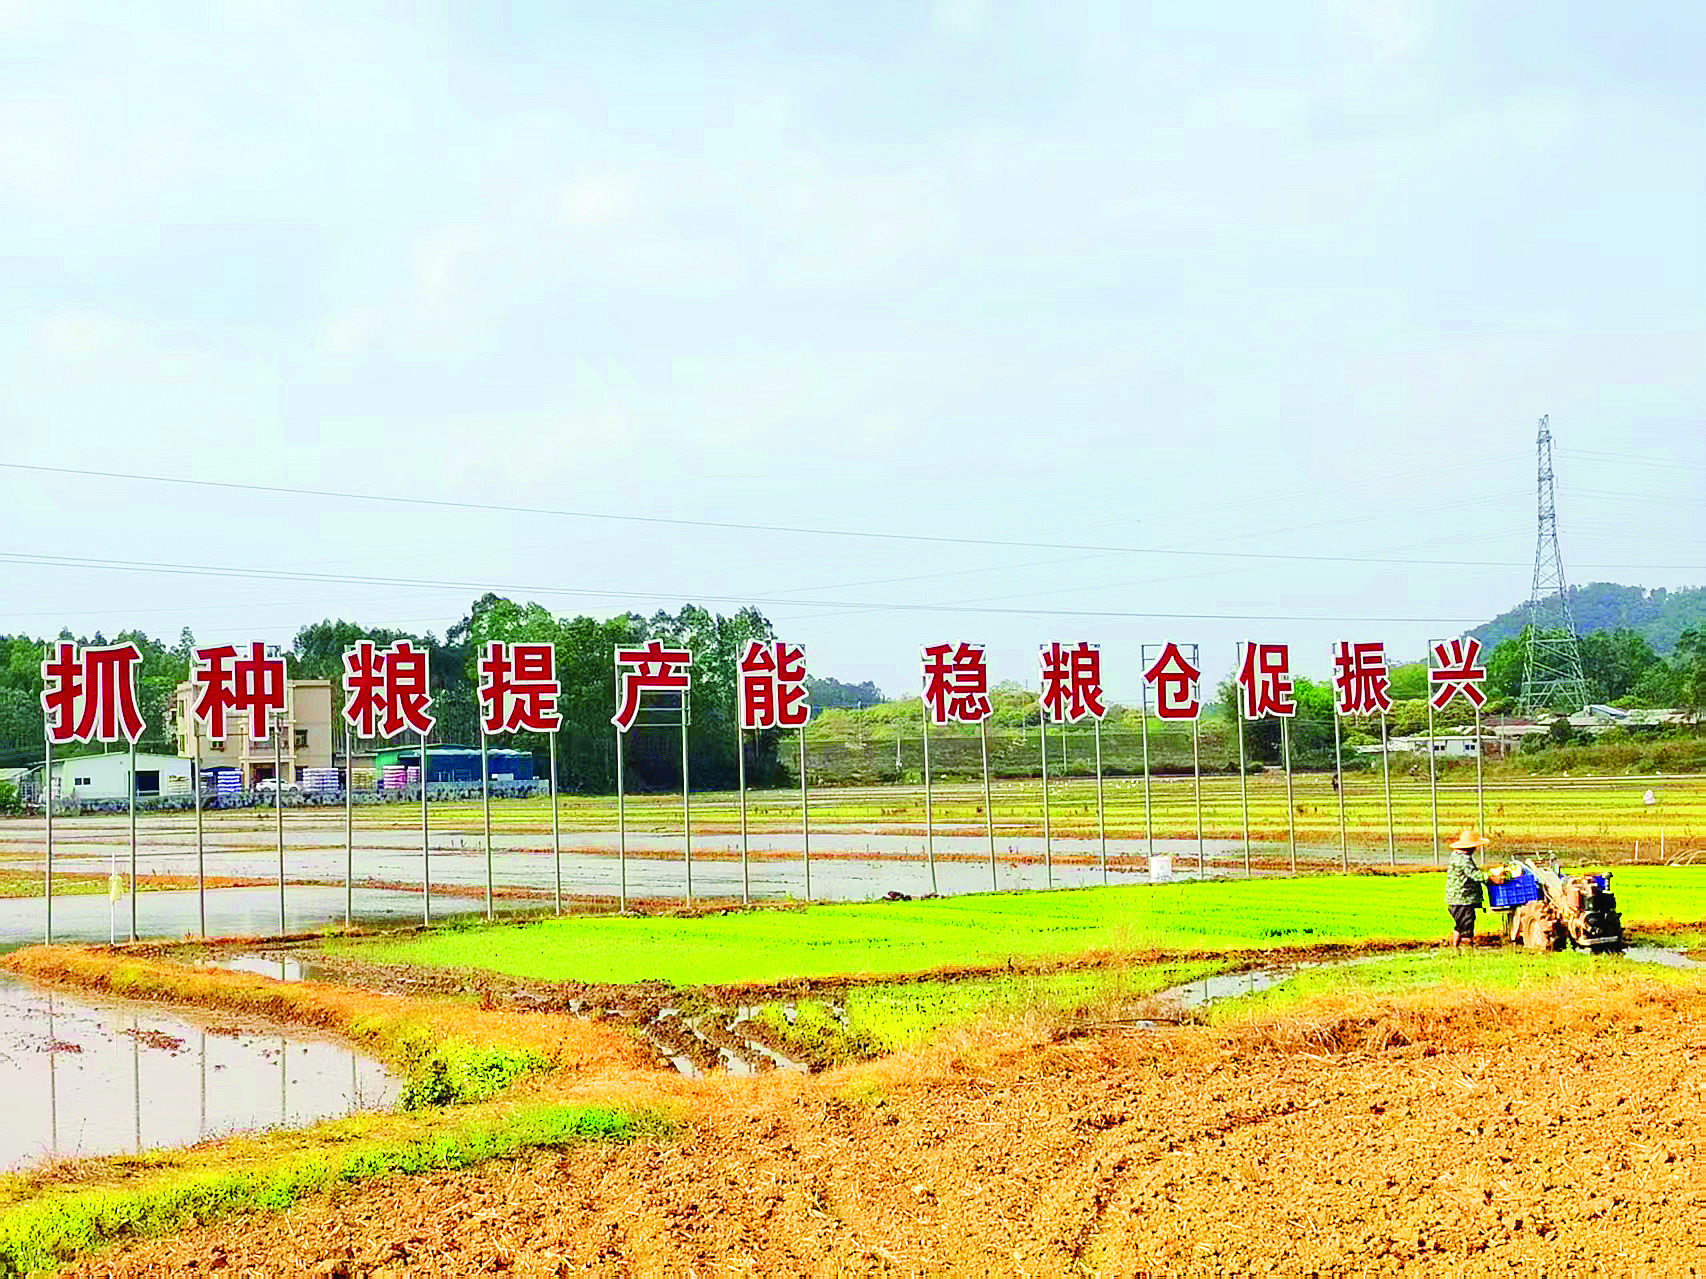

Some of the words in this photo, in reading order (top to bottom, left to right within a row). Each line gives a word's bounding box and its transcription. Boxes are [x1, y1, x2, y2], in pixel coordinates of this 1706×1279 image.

[42, 640, 809, 744] 抓种粮提产能
[922, 636, 1487, 725] 稳粮仓促振兴
